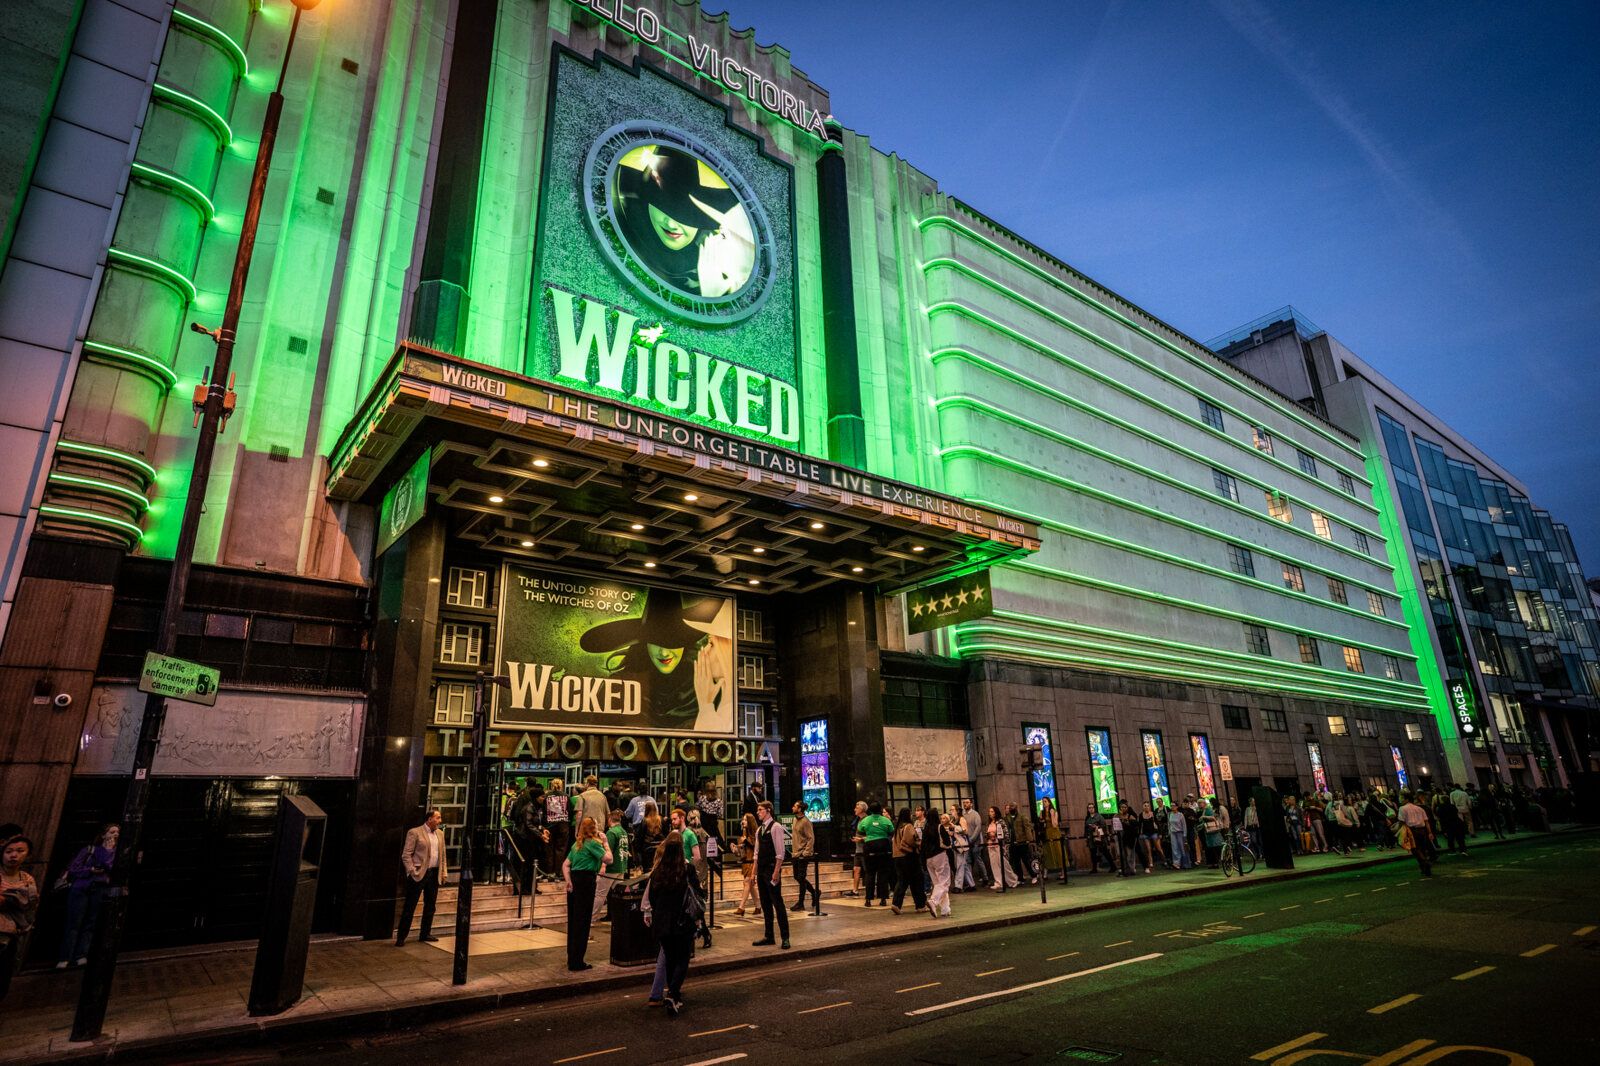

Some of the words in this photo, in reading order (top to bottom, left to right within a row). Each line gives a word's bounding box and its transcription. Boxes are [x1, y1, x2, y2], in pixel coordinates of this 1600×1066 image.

[578, 0, 659, 43] LLO
[687, 34, 829, 141] VICTORIA
[543, 389, 599, 423] THE
[614, 410, 820, 482] UNFORGETTABLE
[830, 467, 872, 495] LIVE
[881, 482, 983, 524] EXPERIENCE
[518, 575, 540, 589] THE
[542, 579, 586, 595] UNTOLD
[589, 586, 620, 600] STORY
[621, 591, 636, 602] OF
[523, 589, 546, 603] THE
[547, 592, 595, 609] WITCHES
[596, 600, 612, 611] OF
[613, 602, 630, 614] OZ
[145, 667, 195, 686] enforcement
[161, 659, 186, 674] Traffic
[151, 680, 185, 695] cameras
[438, 728, 501, 758] THE
[512, 731, 639, 761] APOLLO
[649, 737, 775, 764] VICTORIA
